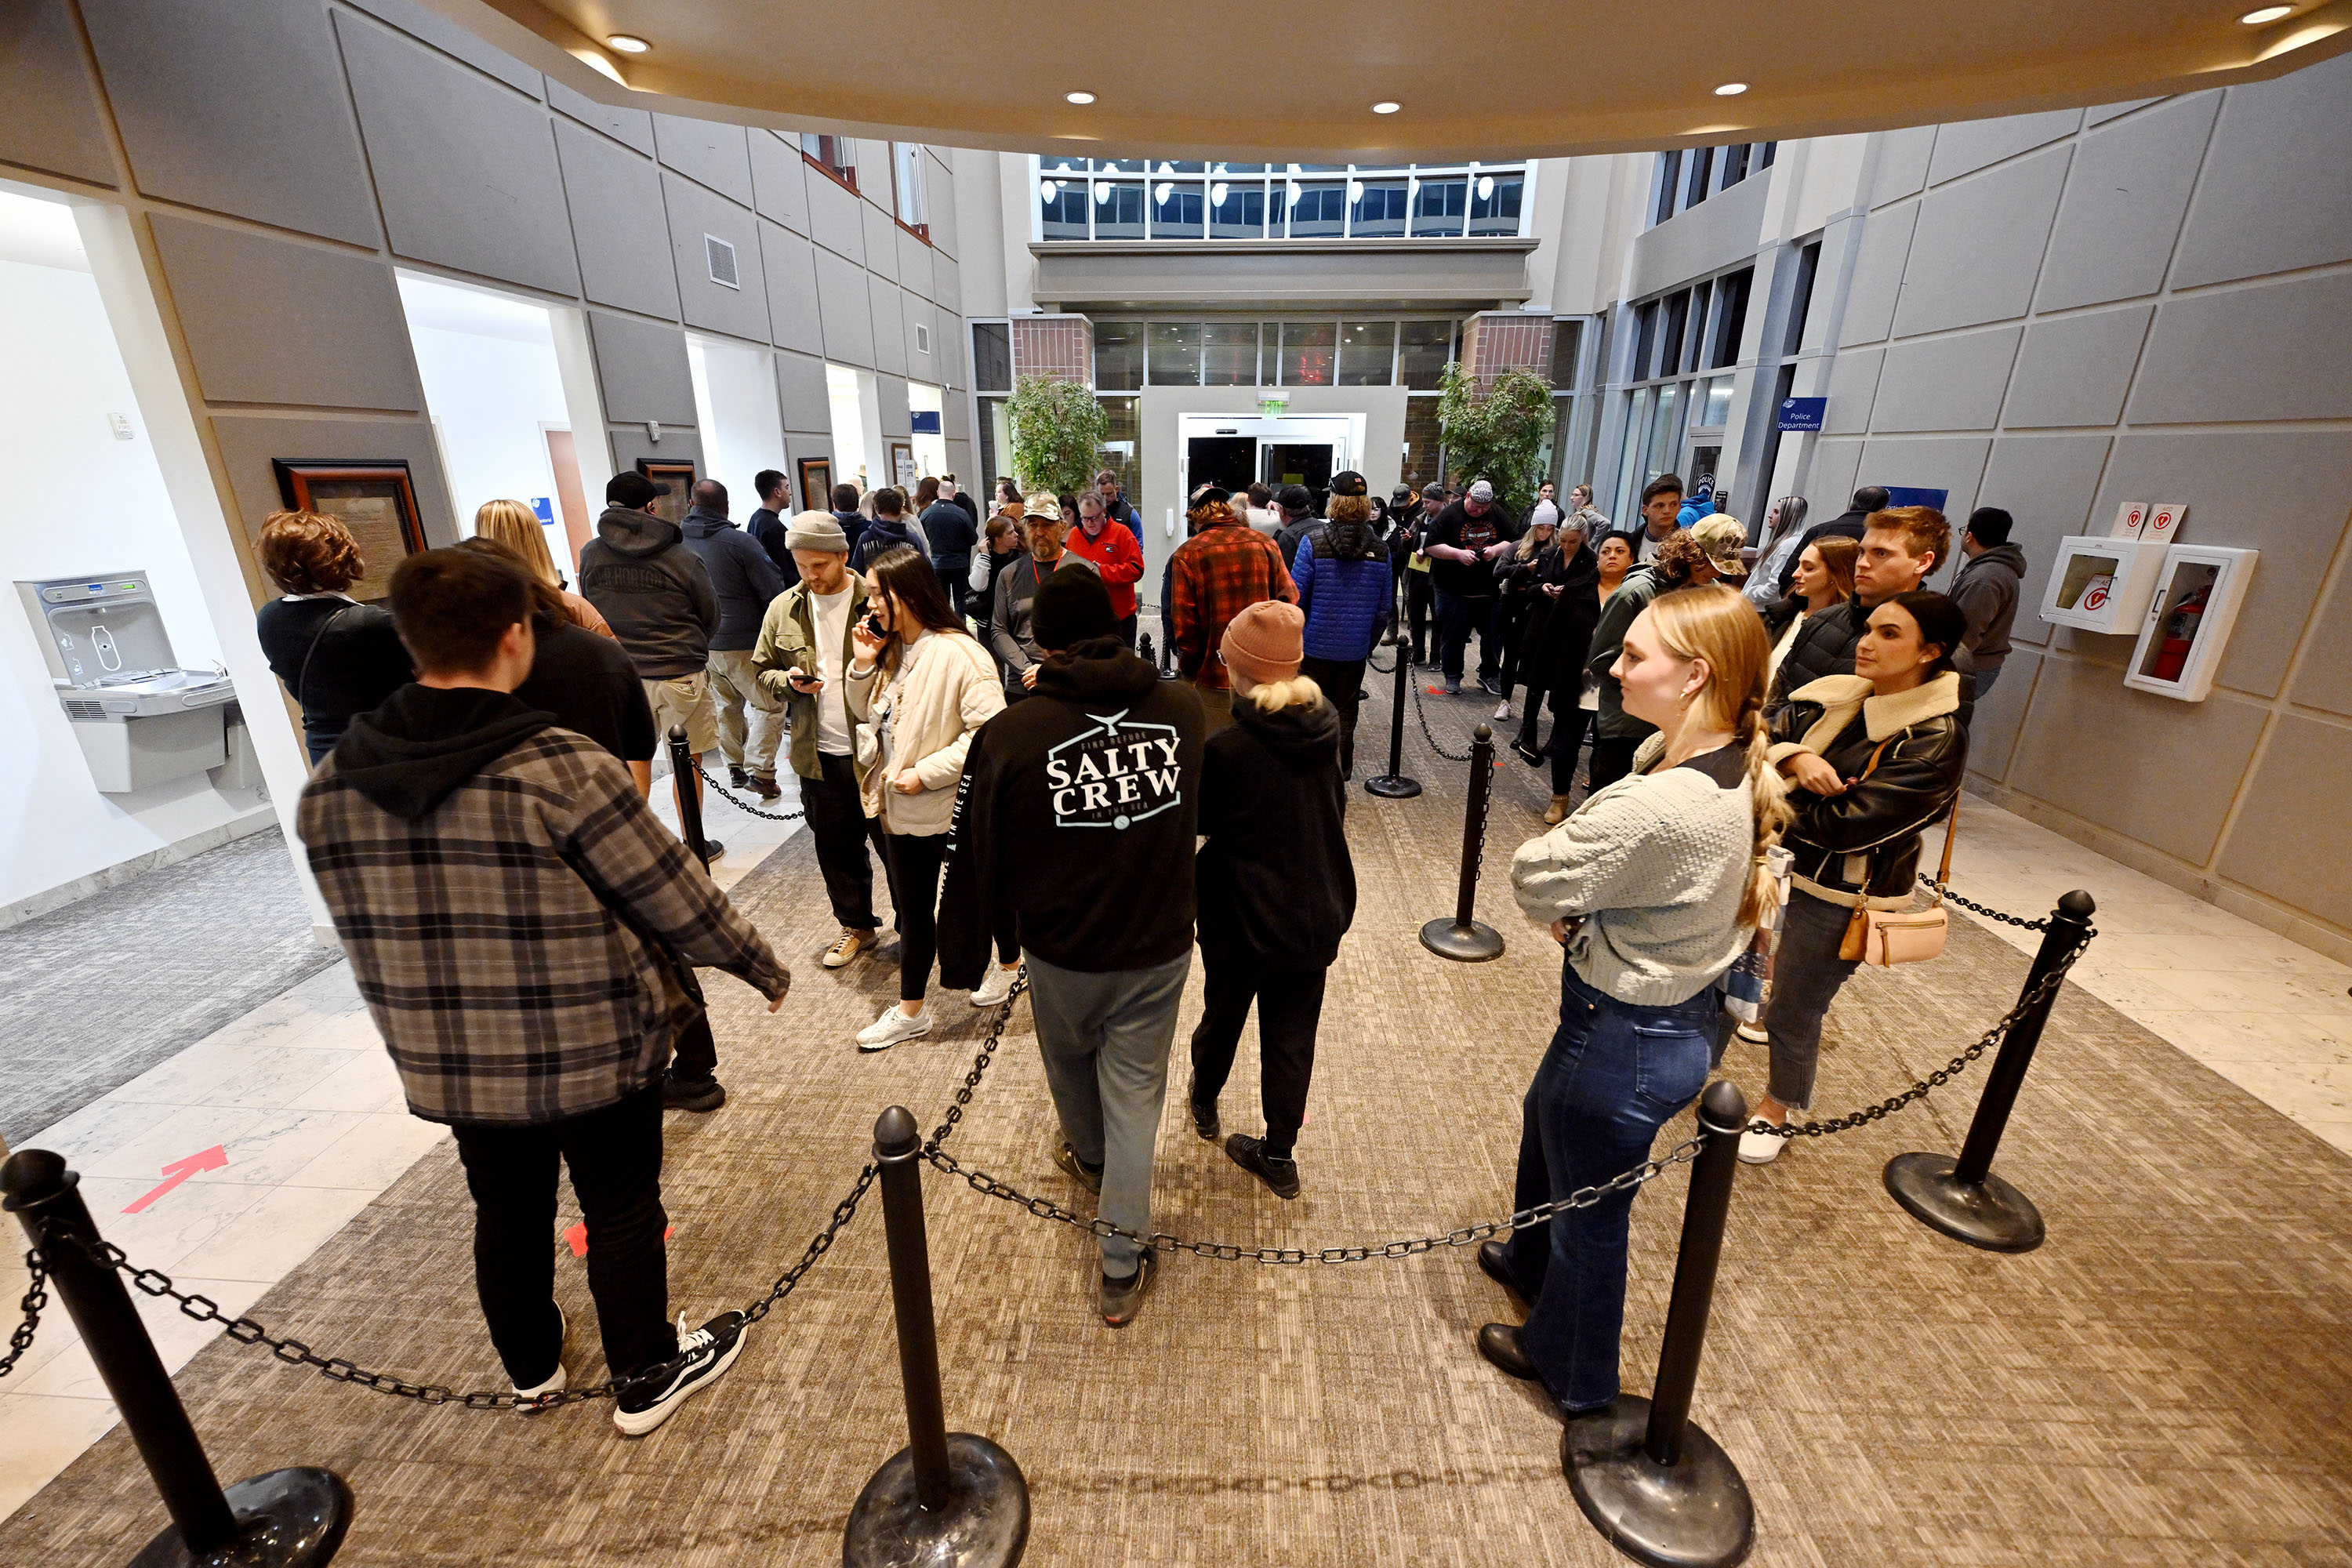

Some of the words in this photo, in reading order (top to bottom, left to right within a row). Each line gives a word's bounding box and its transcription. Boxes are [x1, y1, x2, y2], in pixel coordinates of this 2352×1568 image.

[1777, 422, 1819, 430] Department
[1698, 476, 1715, 487] POLICE
[1080, 740, 1105, 751] FIND
[1110, 731, 1147, 745] REFUGE
[1047, 736, 1181, 789] SALTY
[958, 774, 973, 794] SEA
[1053, 766, 1181, 815] CREW
[953, 798, 964, 818] THE
[1108, 805, 1126, 816] THE
[1131, 801, 1149, 811] SEA
[949, 823, 957, 836] IN
